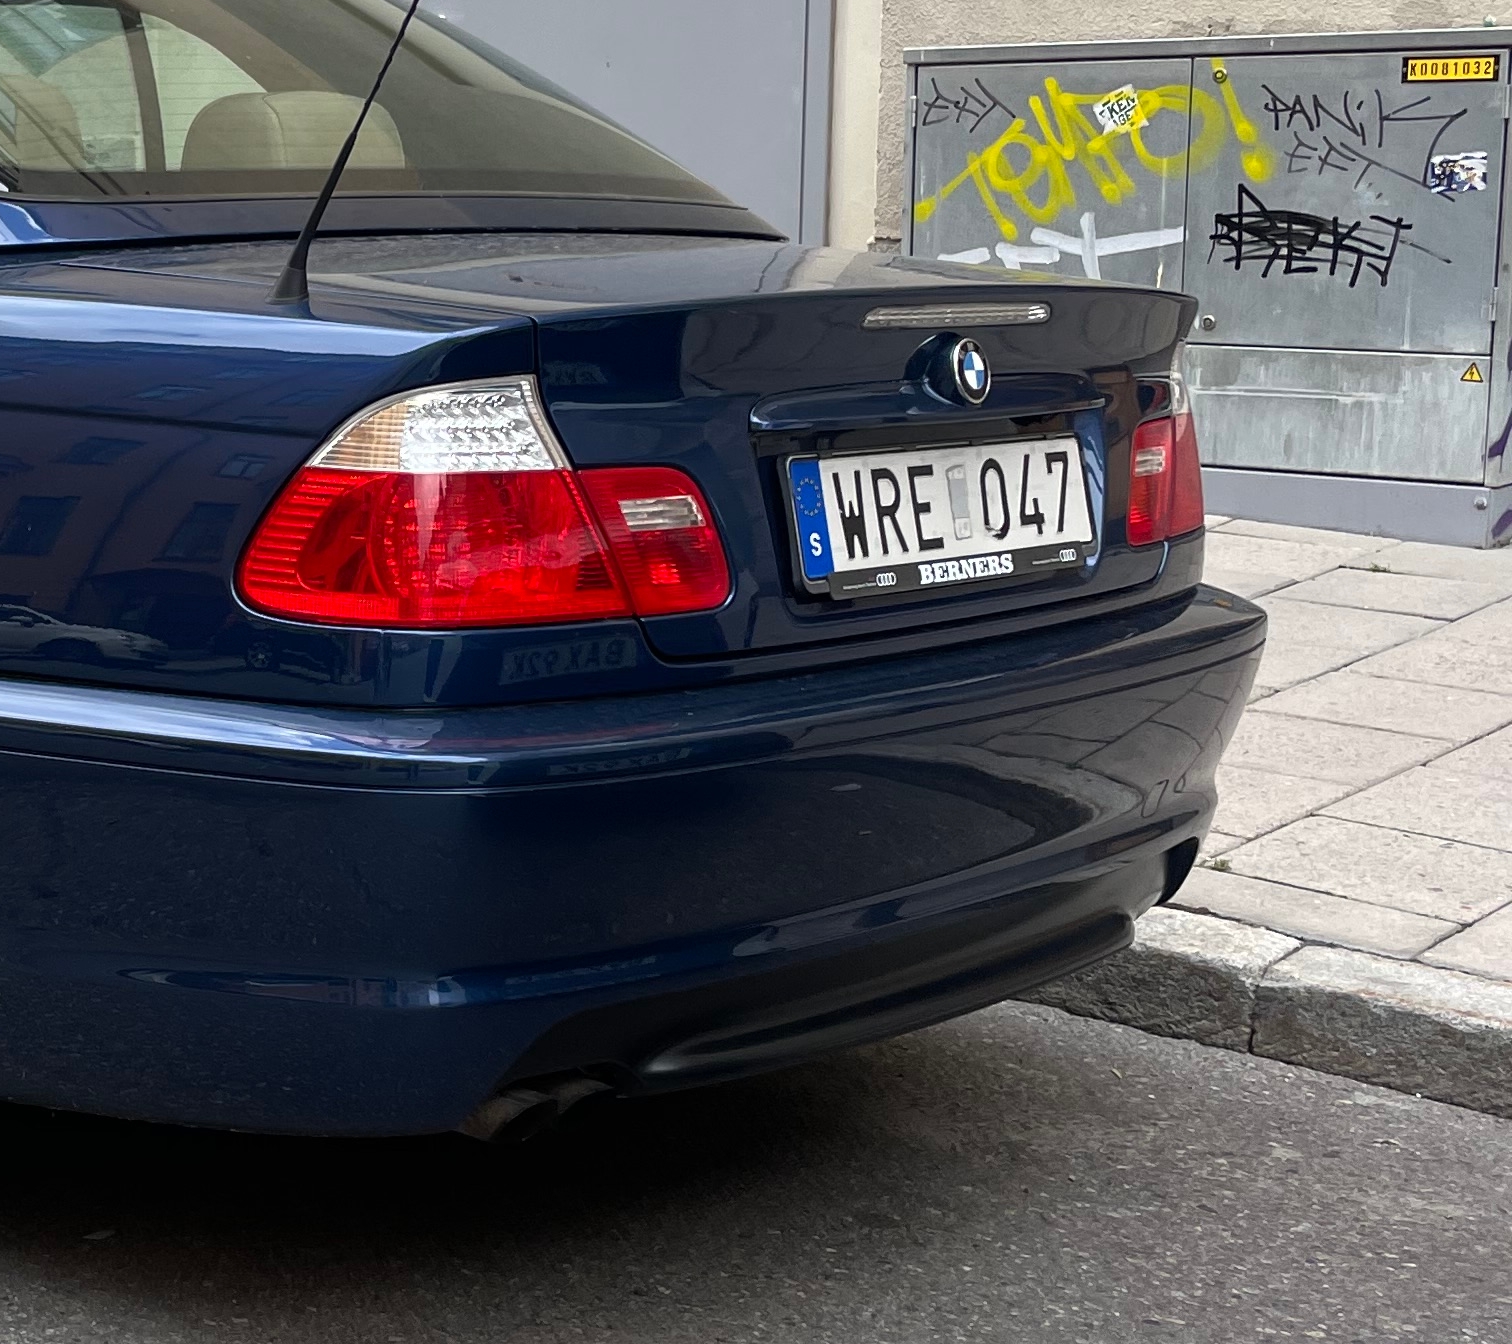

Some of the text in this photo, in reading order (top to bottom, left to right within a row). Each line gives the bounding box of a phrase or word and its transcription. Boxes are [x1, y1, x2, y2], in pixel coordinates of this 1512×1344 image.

[1410, 61, 1491, 76] K0081032
[832, 451, 1069, 560] WRE 047
[809, 532, 822, 556] S
[918, 553, 1014, 586] BERNERS
